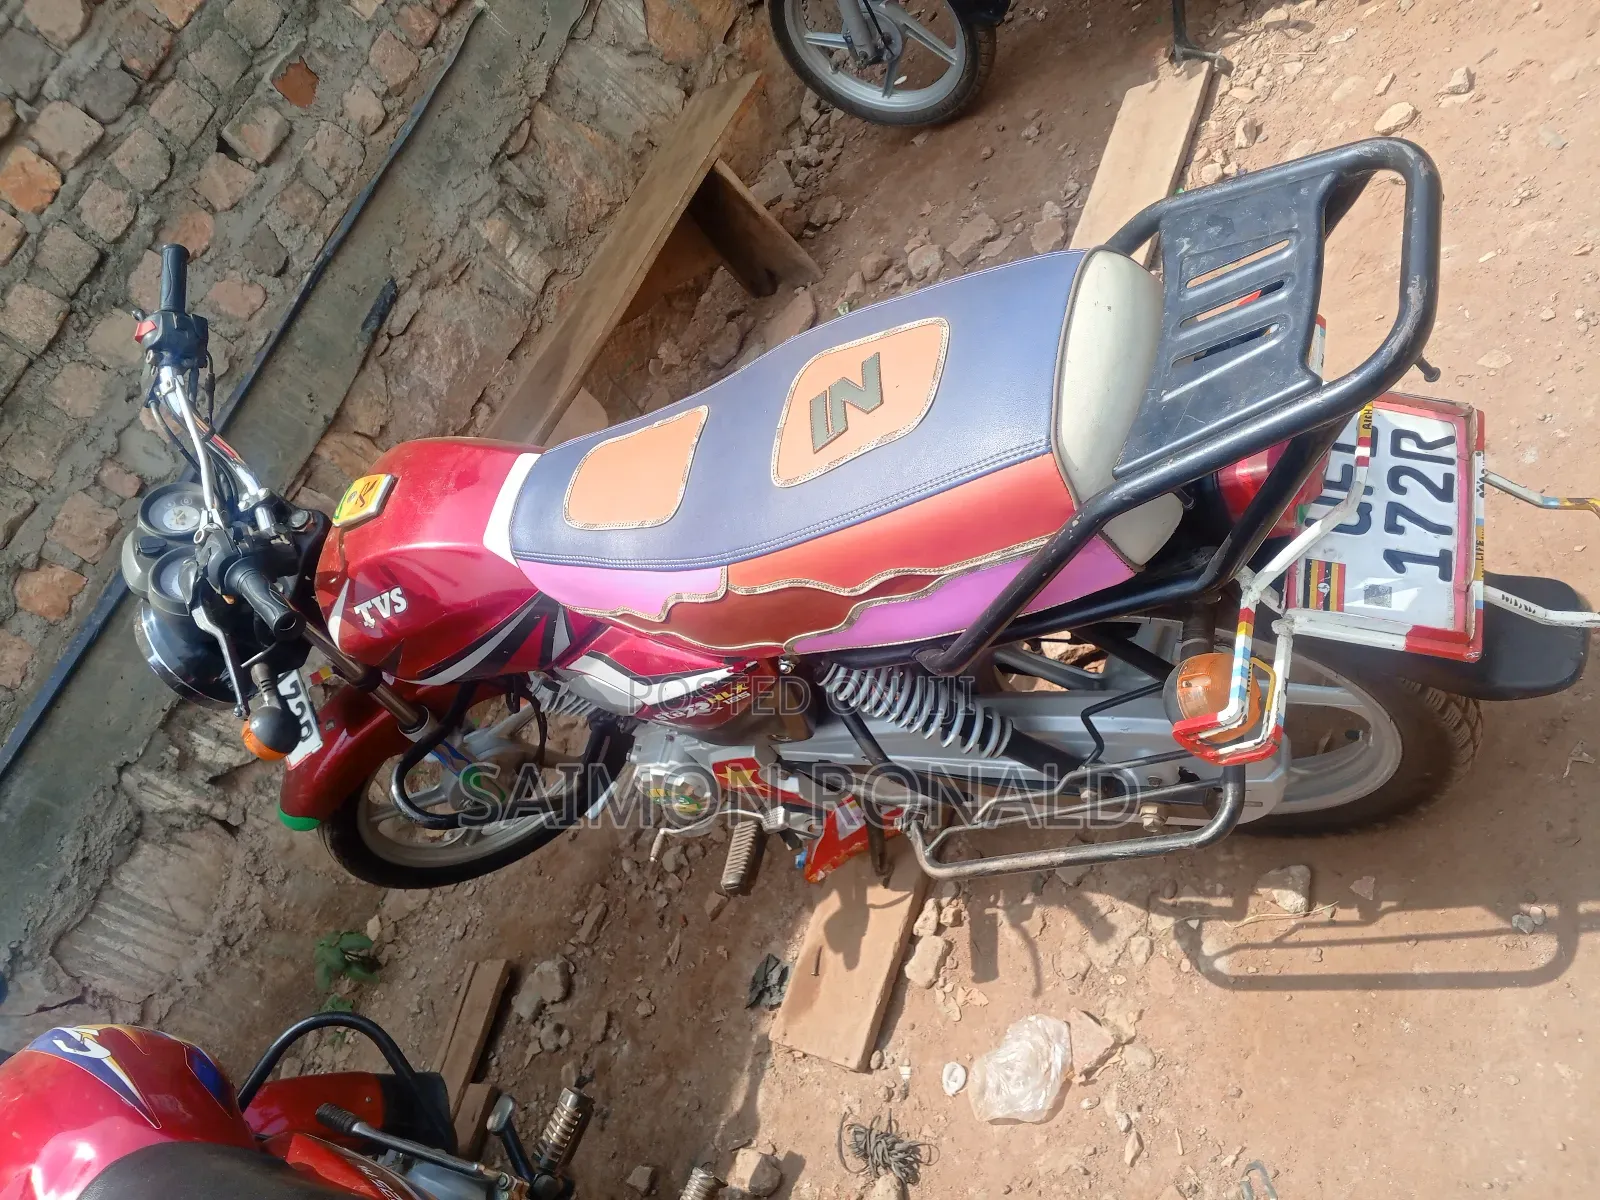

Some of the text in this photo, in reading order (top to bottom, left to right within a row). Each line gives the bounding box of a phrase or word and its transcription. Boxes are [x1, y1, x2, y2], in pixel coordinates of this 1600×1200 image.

[809, 351, 885, 455] IN
[1382, 428, 1456, 582] 172R
[353, 585, 408, 629] TVS
